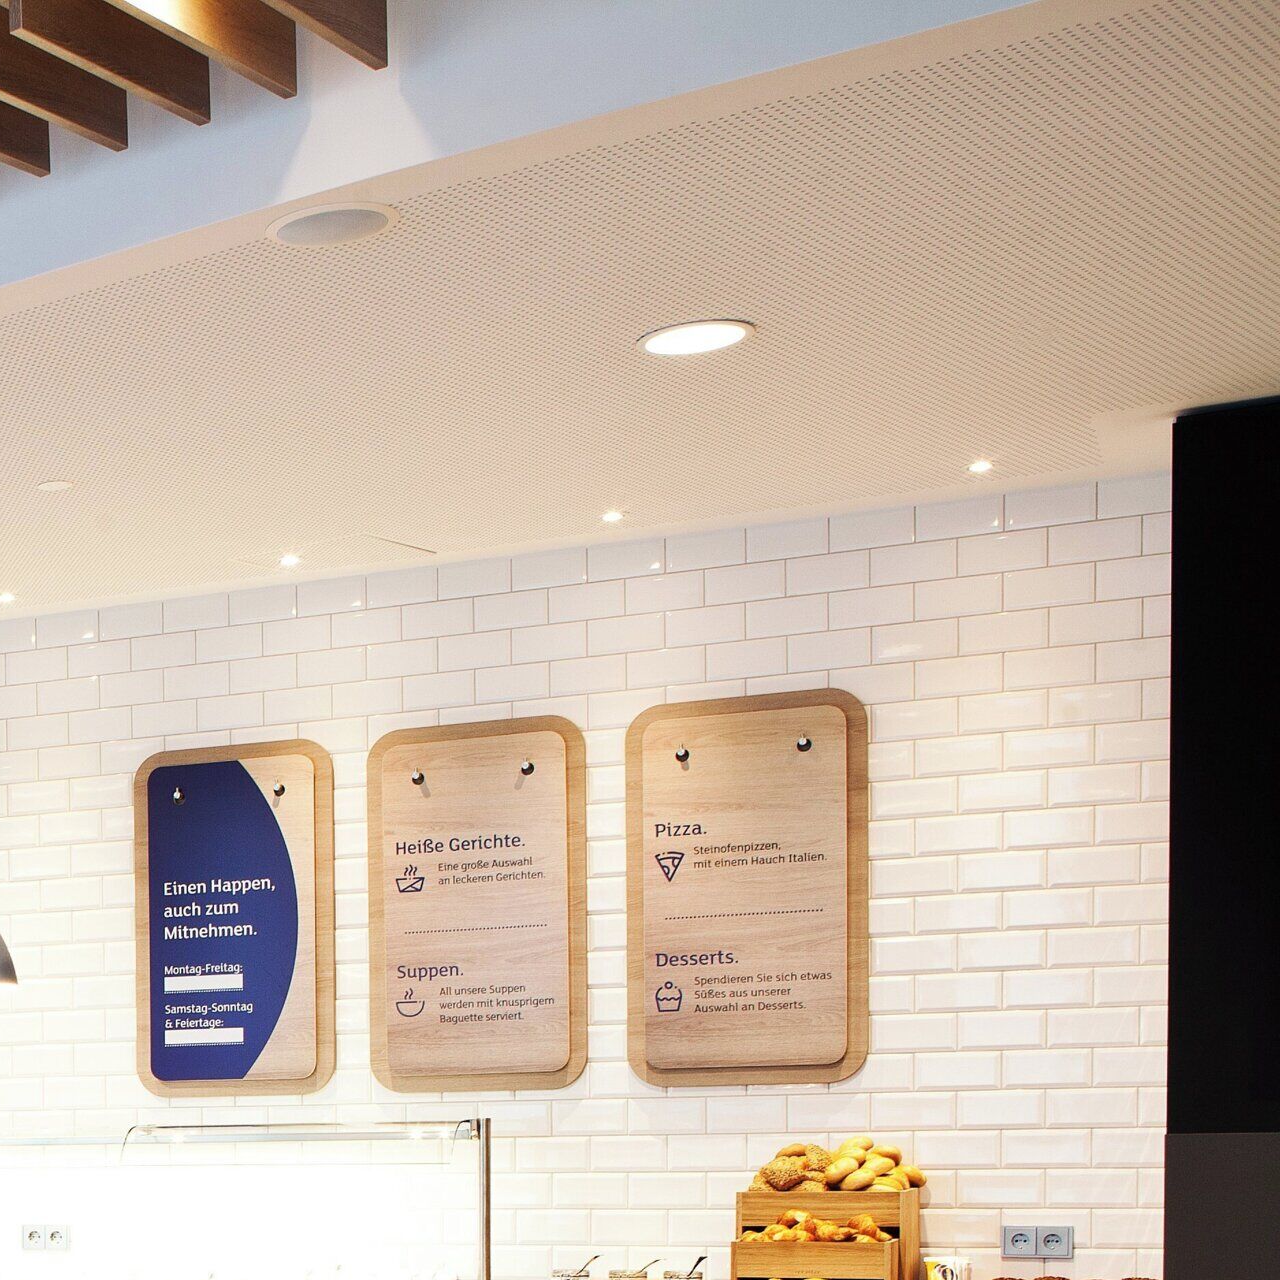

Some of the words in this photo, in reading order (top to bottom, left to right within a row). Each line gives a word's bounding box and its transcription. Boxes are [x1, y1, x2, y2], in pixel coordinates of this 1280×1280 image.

[655, 823, 707, 837] Pizza.
[396, 838, 443, 855] Heiße
[449, 835, 525, 851] Gerichte.
[693, 842, 781, 855] Steinofenpizzen,
[438, 863, 458, 872] Eine
[461, 860, 489, 873] große
[492, 857, 533, 868] Auswahl
[694, 860, 711, 869] mit
[715, 857, 748, 867] einem
[751, 855, 785, 865] Hauch
[789, 852, 827, 863] Italien.
[438, 877, 450, 885] an
[453, 874, 494, 884] leckeren
[496, 870, 546, 882] Gerichten.
[164, 880, 206, 896] Einen
[211, 876, 275, 895] Happen,
[164, 901, 200, 918] auch
[206, 902, 238, 916] zum
[164, 923, 257, 940] Mitnehmen.
[656, 951, 738, 967] Desserts.
[165, 963, 243, 975] Montag-Freitag:
[398, 965, 464, 981] Suppen.
[694, 974, 753, 986] Spendieren
[757, 973, 772, 983] Sie
[776, 972, 797, 982] sich
[801, 971, 832, 981] etwas
[440, 987, 452, 996] All
[454, 987, 487, 995] unsere
[489, 984, 525, 996] Suppen
[694, 989, 726, 999] Süßes
[729, 990, 748, 998] aus
[751, 987, 791, 997] unserer
[165, 1001, 253, 1015] Samstag-Sonntag
[440, 1000, 474, 1010] werden
[477, 1000, 493, 1009] mit
[694, 1002, 738, 1013] Auswahl
[742, 1003, 754, 1011] an
[758, 1001, 806, 1011] Desserts.
[165, 1018, 173, 1028] &
[175, 1017, 224, 1029] Feiertage:
[440, 1013, 483, 1025] Baguette
[486, 1012, 524, 1022] serviert.
